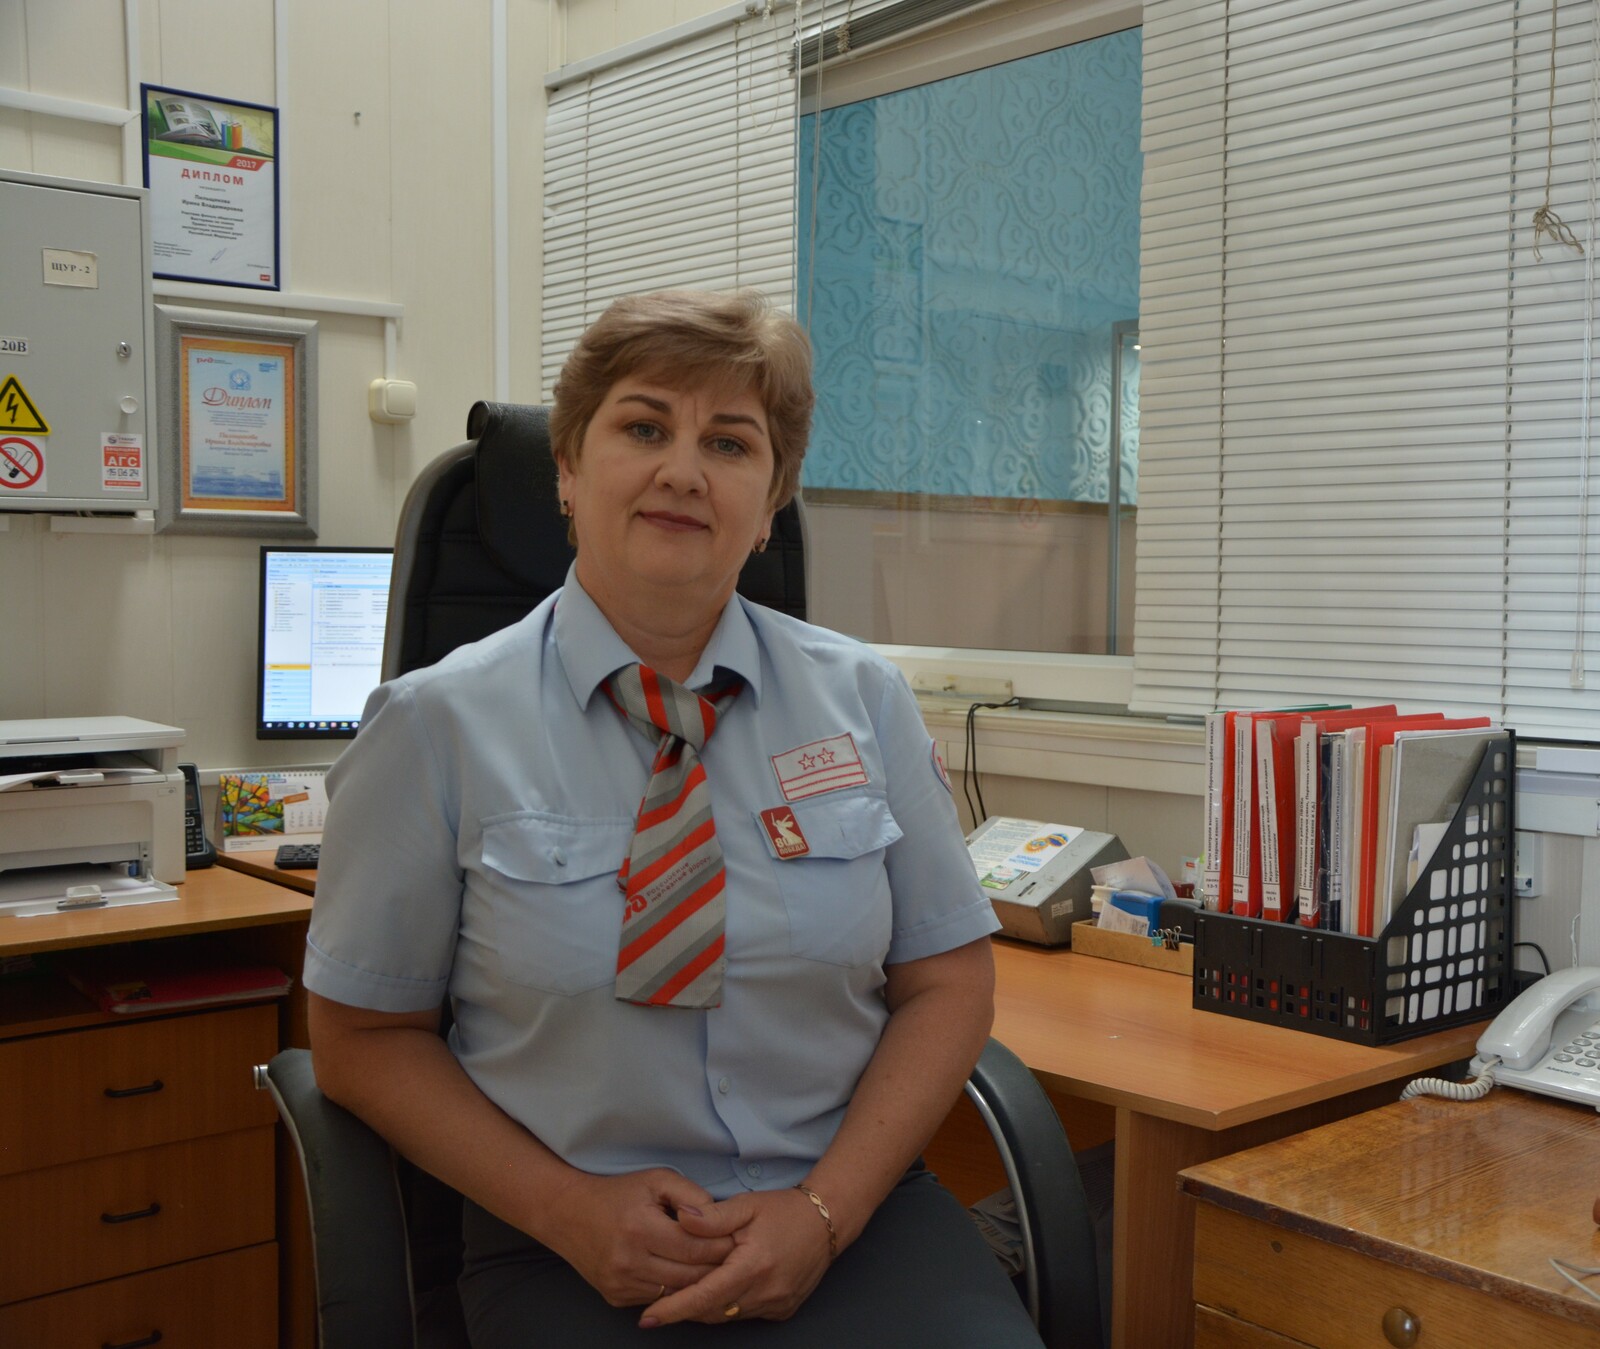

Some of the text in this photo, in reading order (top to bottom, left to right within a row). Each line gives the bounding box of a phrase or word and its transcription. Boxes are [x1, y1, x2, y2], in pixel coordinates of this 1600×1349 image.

[236, 159, 256, 168] 2017
[181, 168, 244, 186] ДИПЛОМ
[84, 266, 90, 274] 2
[0, 340, 26, 352] 20В
[202, 387, 272, 410] Диплом
[107, 456, 138, 467] АГС
[775, 837, 789, 848] 80
[646, 862, 689, 896] Российские
[652, 856, 711, 902] железные дороги
